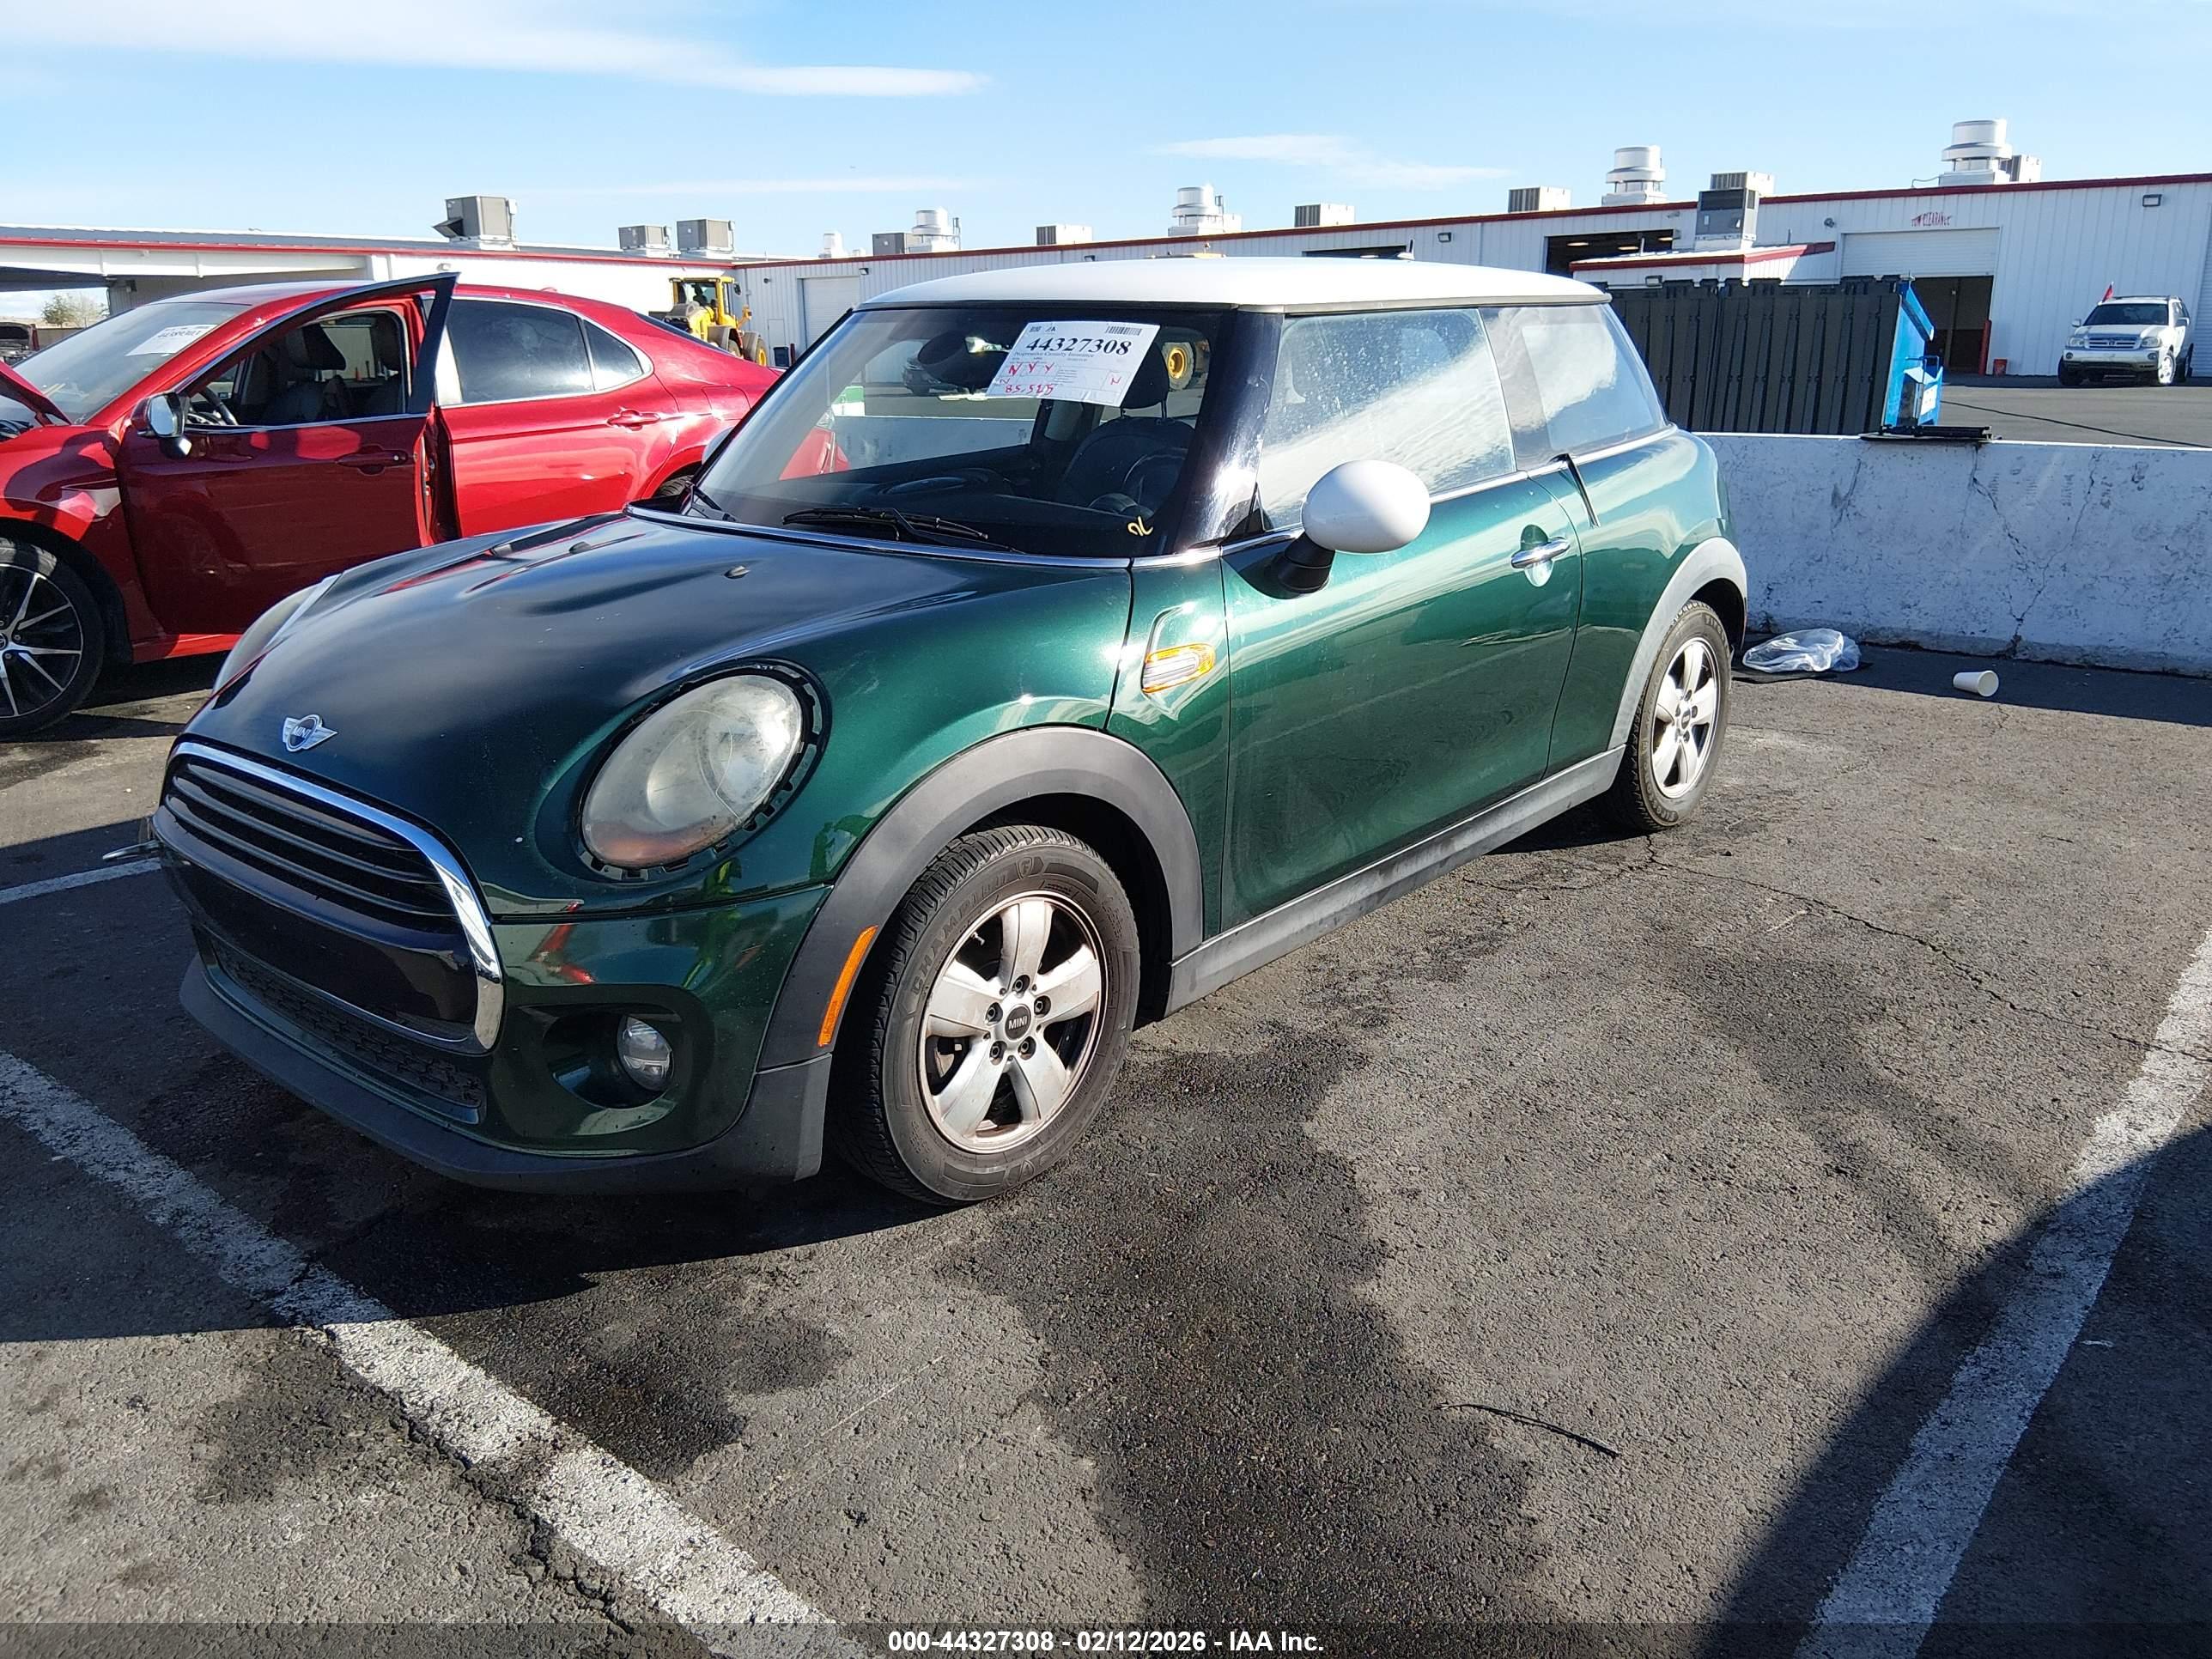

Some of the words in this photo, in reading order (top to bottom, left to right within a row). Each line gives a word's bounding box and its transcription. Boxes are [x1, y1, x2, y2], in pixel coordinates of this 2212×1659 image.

[1026, 337, 1132, 356] 44327308
[293, 726, 312, 738] MINI
[1008, 1015, 1028, 1030] MINI
